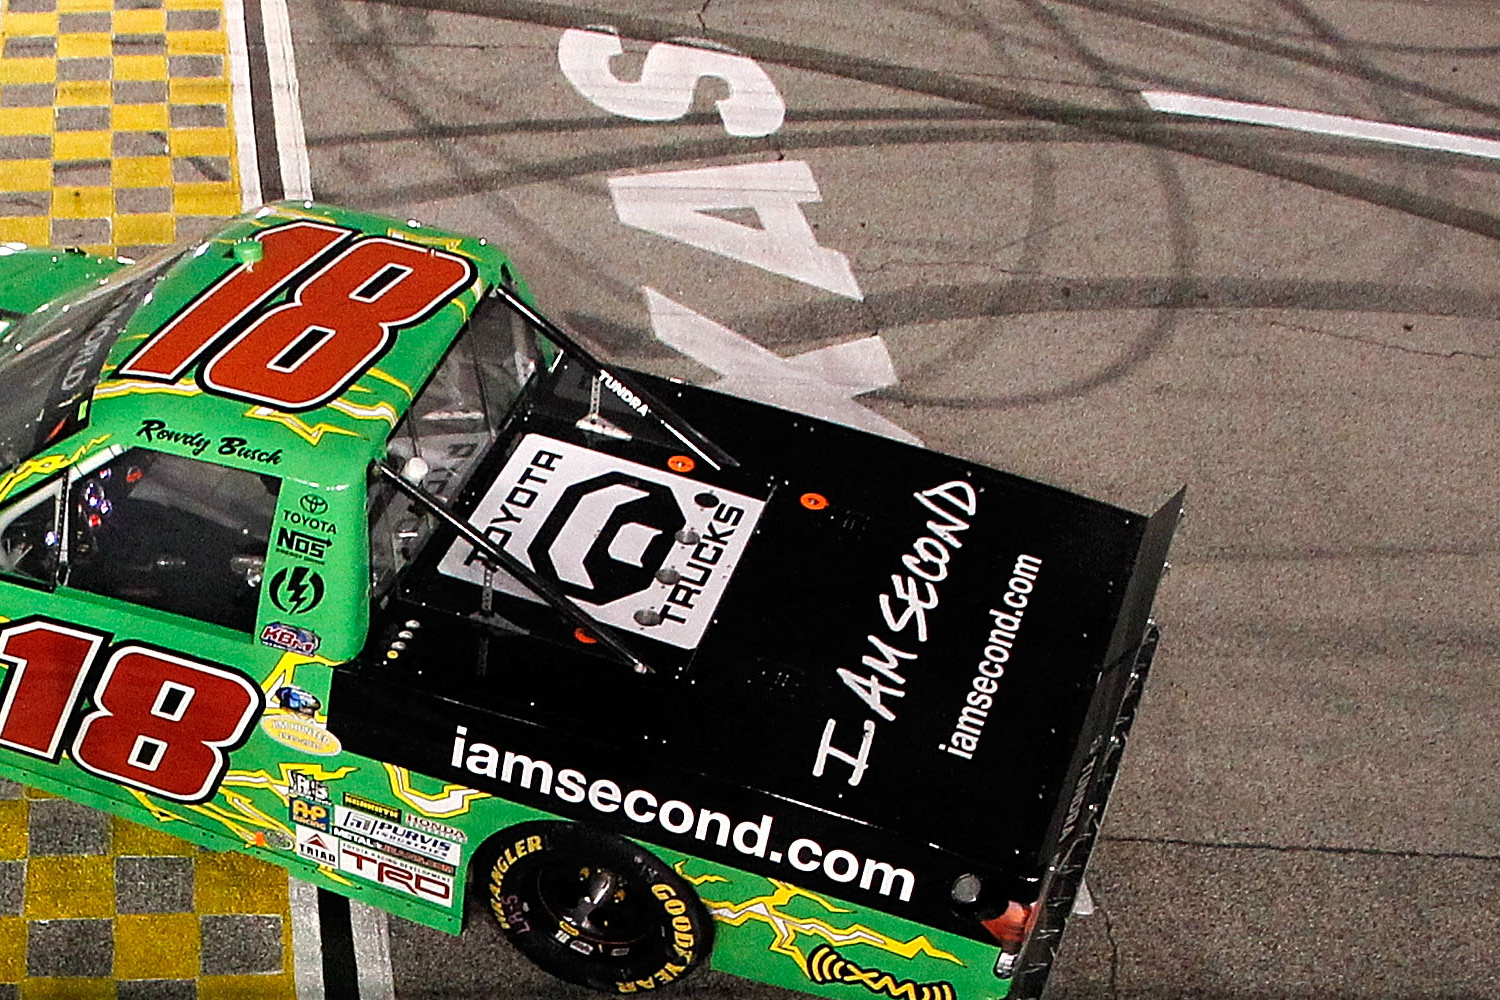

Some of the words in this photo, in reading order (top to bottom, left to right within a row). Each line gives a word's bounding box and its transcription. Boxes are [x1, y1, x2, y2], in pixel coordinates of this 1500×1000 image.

[558, 25, 926, 447] XAS
[112, 219, 477, 411] 18
[598, 370, 651, 417] TUNDRA
[136, 420, 210, 456] Rowdy
[219, 436, 285, 467] Busch
[283, 510, 337, 535] TOYOTA
[659, 502, 746, 625] TRUCKS
[879, 481, 976, 641] SECOND
[837, 636, 917, 721] AM
[939, 554, 1042, 759] iamsecond.com
[813, 719, 875, 786] I
[300, 842, 336, 863] TRIAD
[378, 822, 450, 852] PURVIS
[407, 814, 466, 839] HONDA
[451, 725, 916, 902] iamsecond.com
[343, 848, 450, 899] TRD
[489, 835, 543, 930] WRANGLER
[616, 883, 696, 993] GOODYEAR
